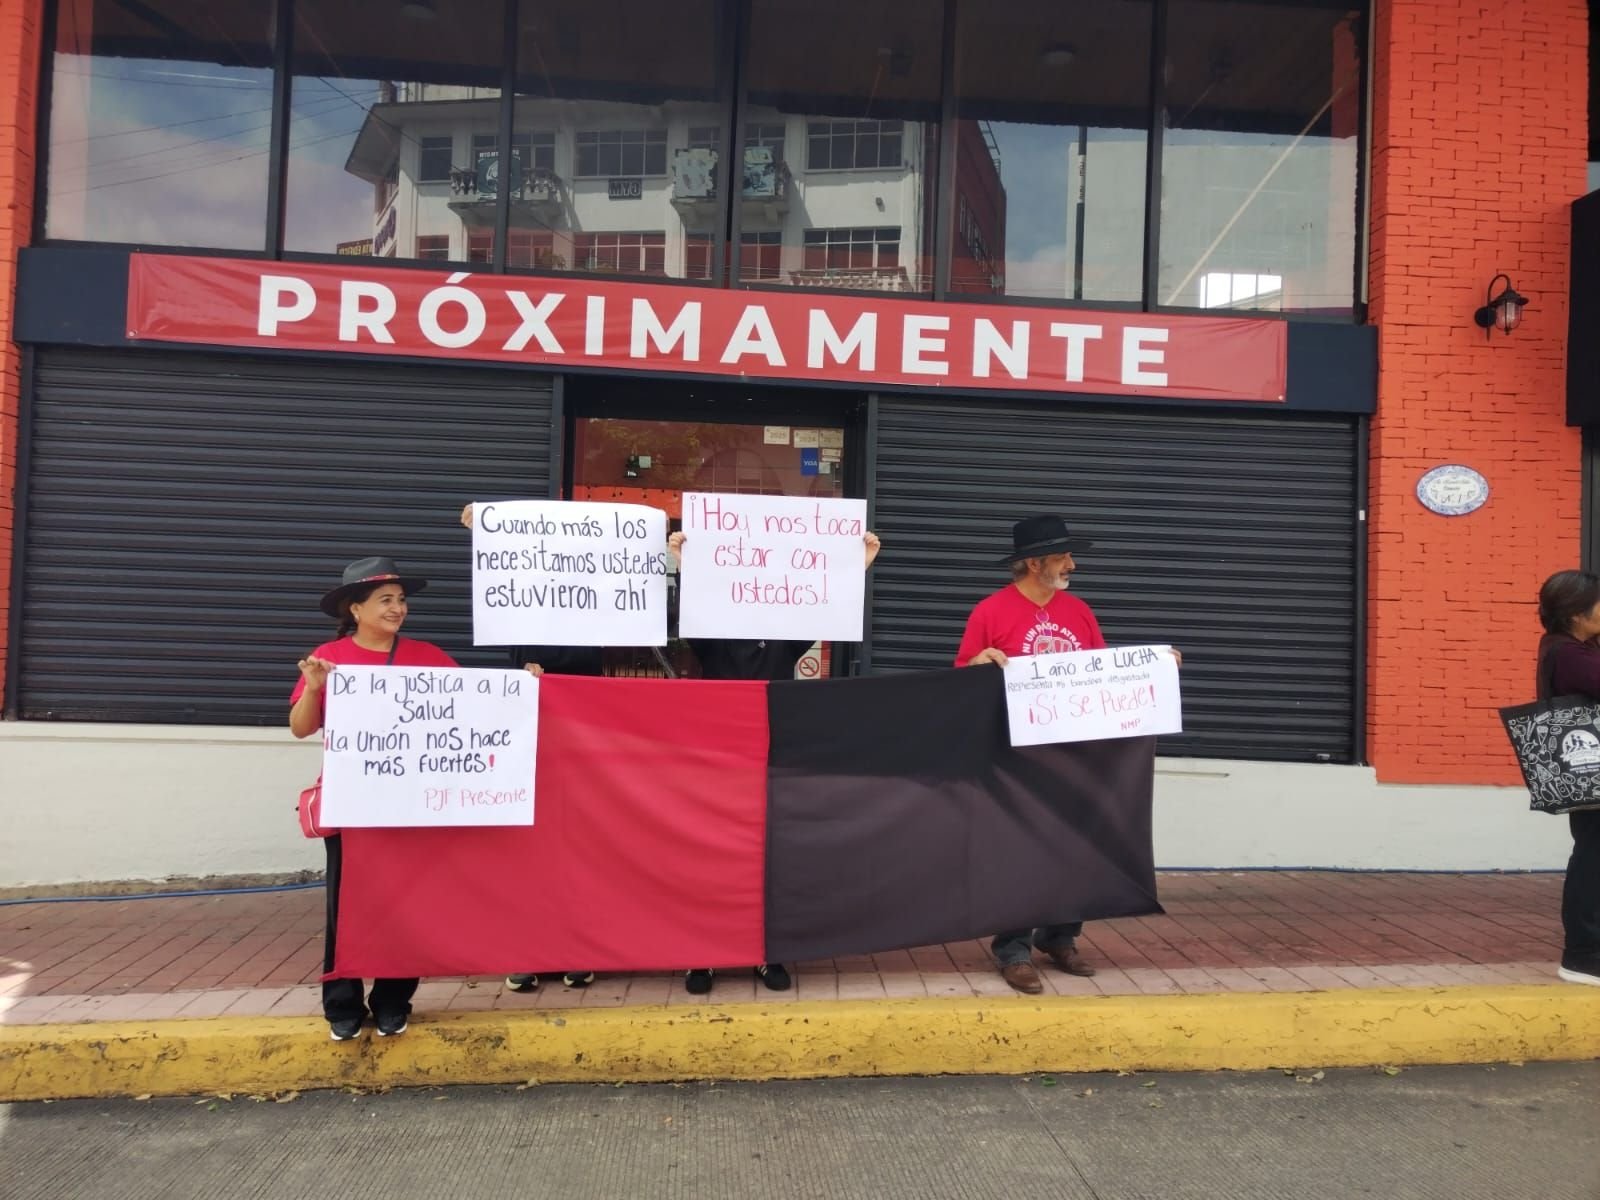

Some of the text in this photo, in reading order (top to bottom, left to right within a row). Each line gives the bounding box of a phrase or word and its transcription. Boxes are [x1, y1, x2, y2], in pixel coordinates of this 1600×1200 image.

[257, 272, 1169, 387] PRÓXIMAMENTE
[481, 505, 647, 539] Cuando más los
[690, 495, 862, 538] ¡Hoy nos toca
[477, 539, 667, 576] necesitamos ustedes
[714, 536, 827, 570] estar con
[485, 578, 648, 611] estuvieron ahí
[731, 573, 829, 605] ustedes!
[1025, 627, 1038, 642] UN
[1031, 647, 1159, 680] 1 año de LUCHA
[333, 672, 357, 696] De
[370, 673, 387, 694] la
[477, 679, 491, 694] a
[503, 674, 521, 697] la
[470, 727, 512, 750] hace
[1120, 719, 1141, 731] NMP
[424, 786, 453, 812] PJF
